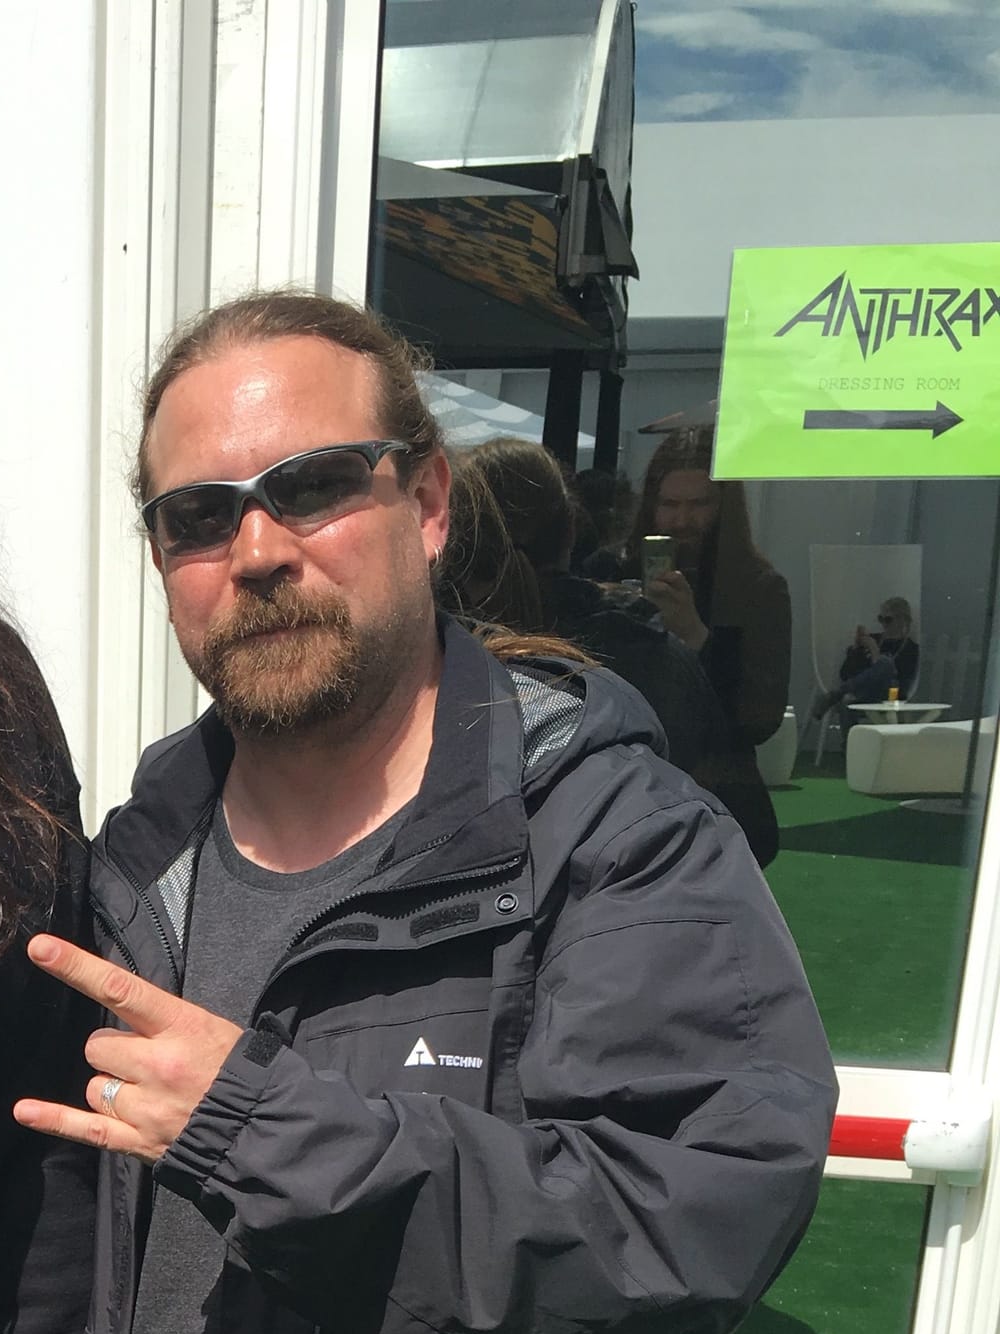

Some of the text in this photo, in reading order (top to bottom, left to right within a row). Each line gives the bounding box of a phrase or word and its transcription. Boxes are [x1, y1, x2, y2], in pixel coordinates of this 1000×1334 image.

[773, 270, 1000, 363] ANTHRAX
[817, 377, 961, 391] DRESSING ROOM
